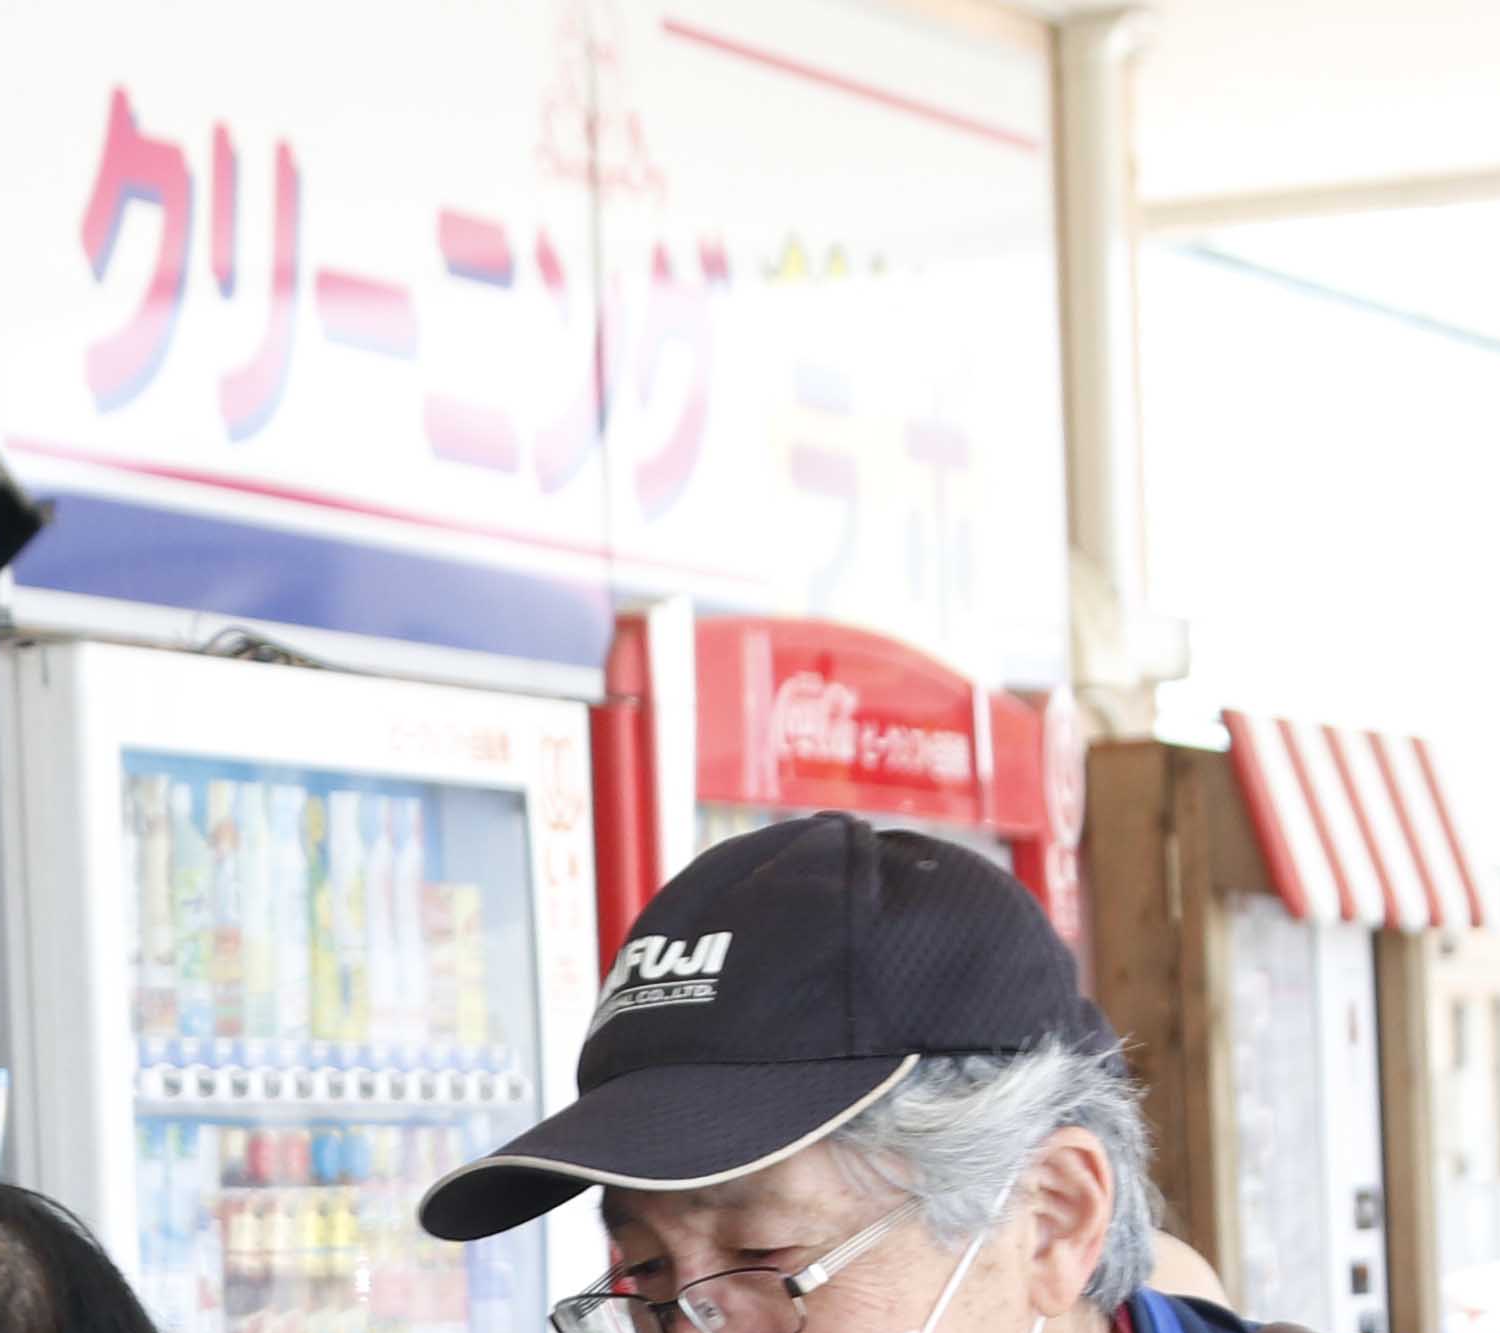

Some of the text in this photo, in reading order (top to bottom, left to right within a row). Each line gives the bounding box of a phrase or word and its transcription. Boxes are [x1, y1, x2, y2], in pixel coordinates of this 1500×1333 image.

[80, 82, 738, 522] クリーニング
